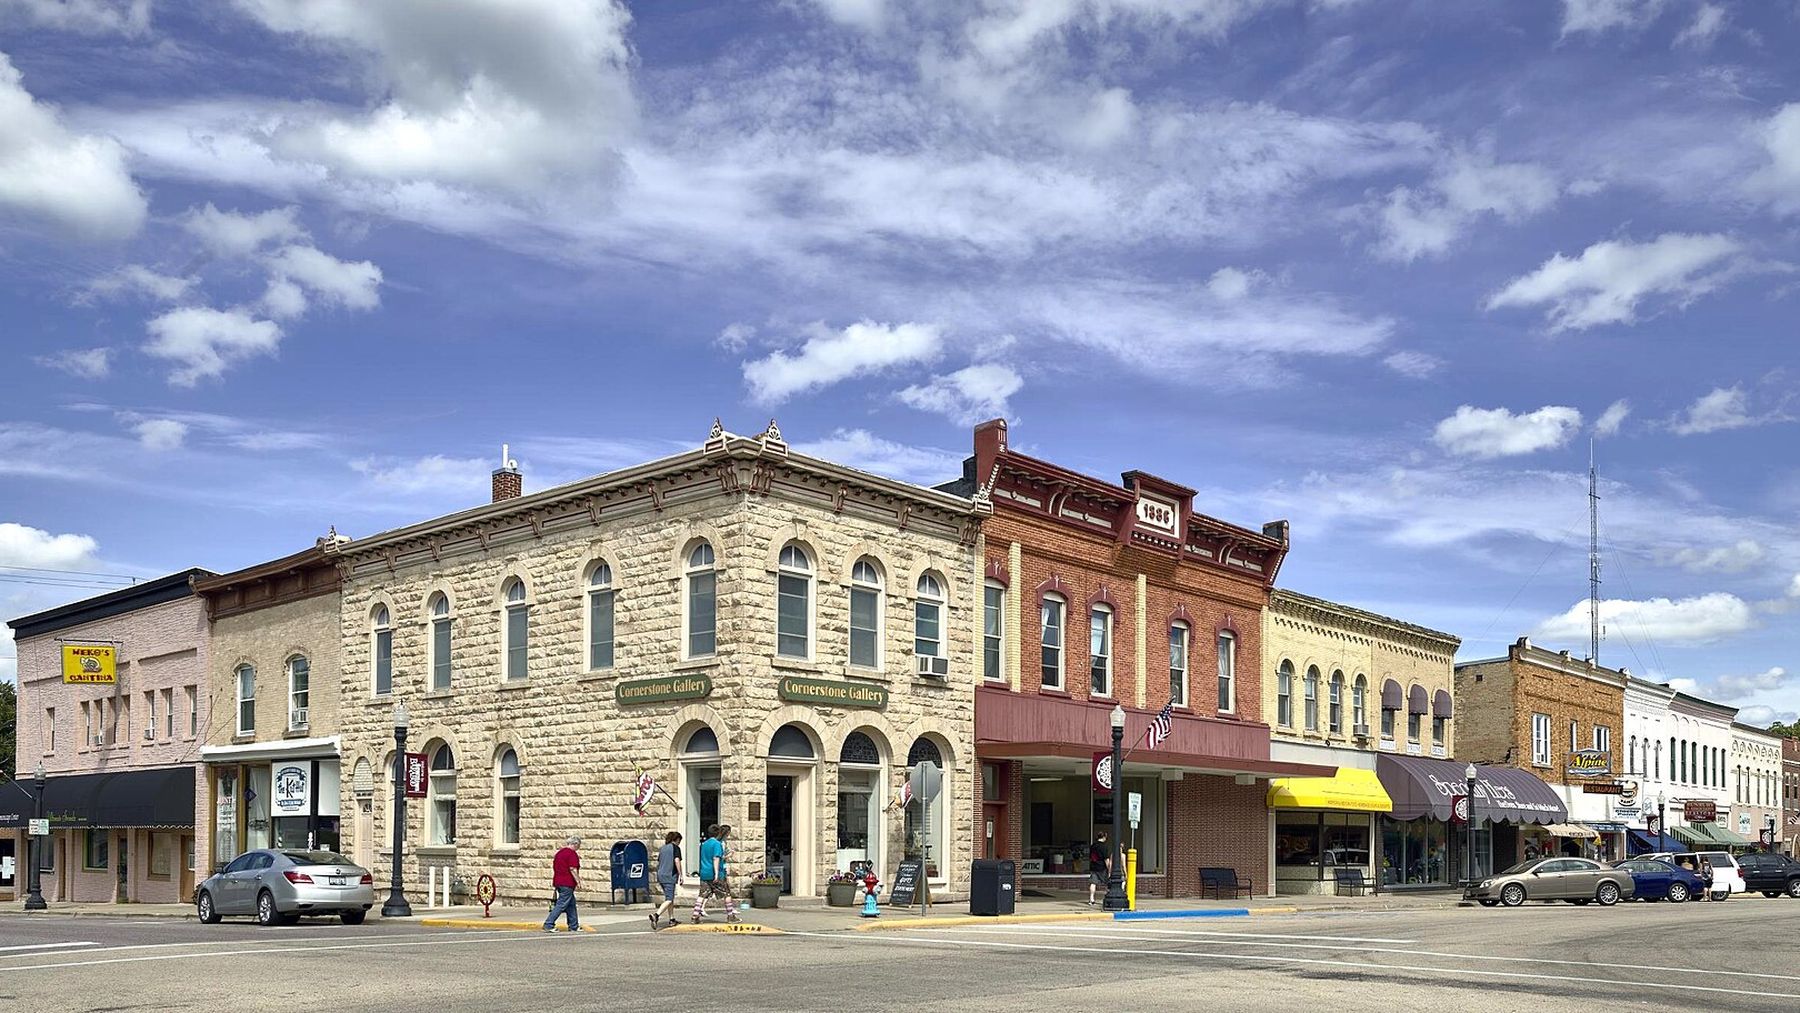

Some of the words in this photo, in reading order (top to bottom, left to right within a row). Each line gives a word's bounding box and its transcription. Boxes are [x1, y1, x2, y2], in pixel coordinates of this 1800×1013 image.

[620, 683, 671, 698] Cornerstone
[673, 679, 705, 694] Gallery
[785, 680, 847, 698] Cornerstone
[849, 687, 883, 704] Gallery
[1570, 754, 1607, 768] Alpine
[1022, 862, 1040, 870] ATTIC
